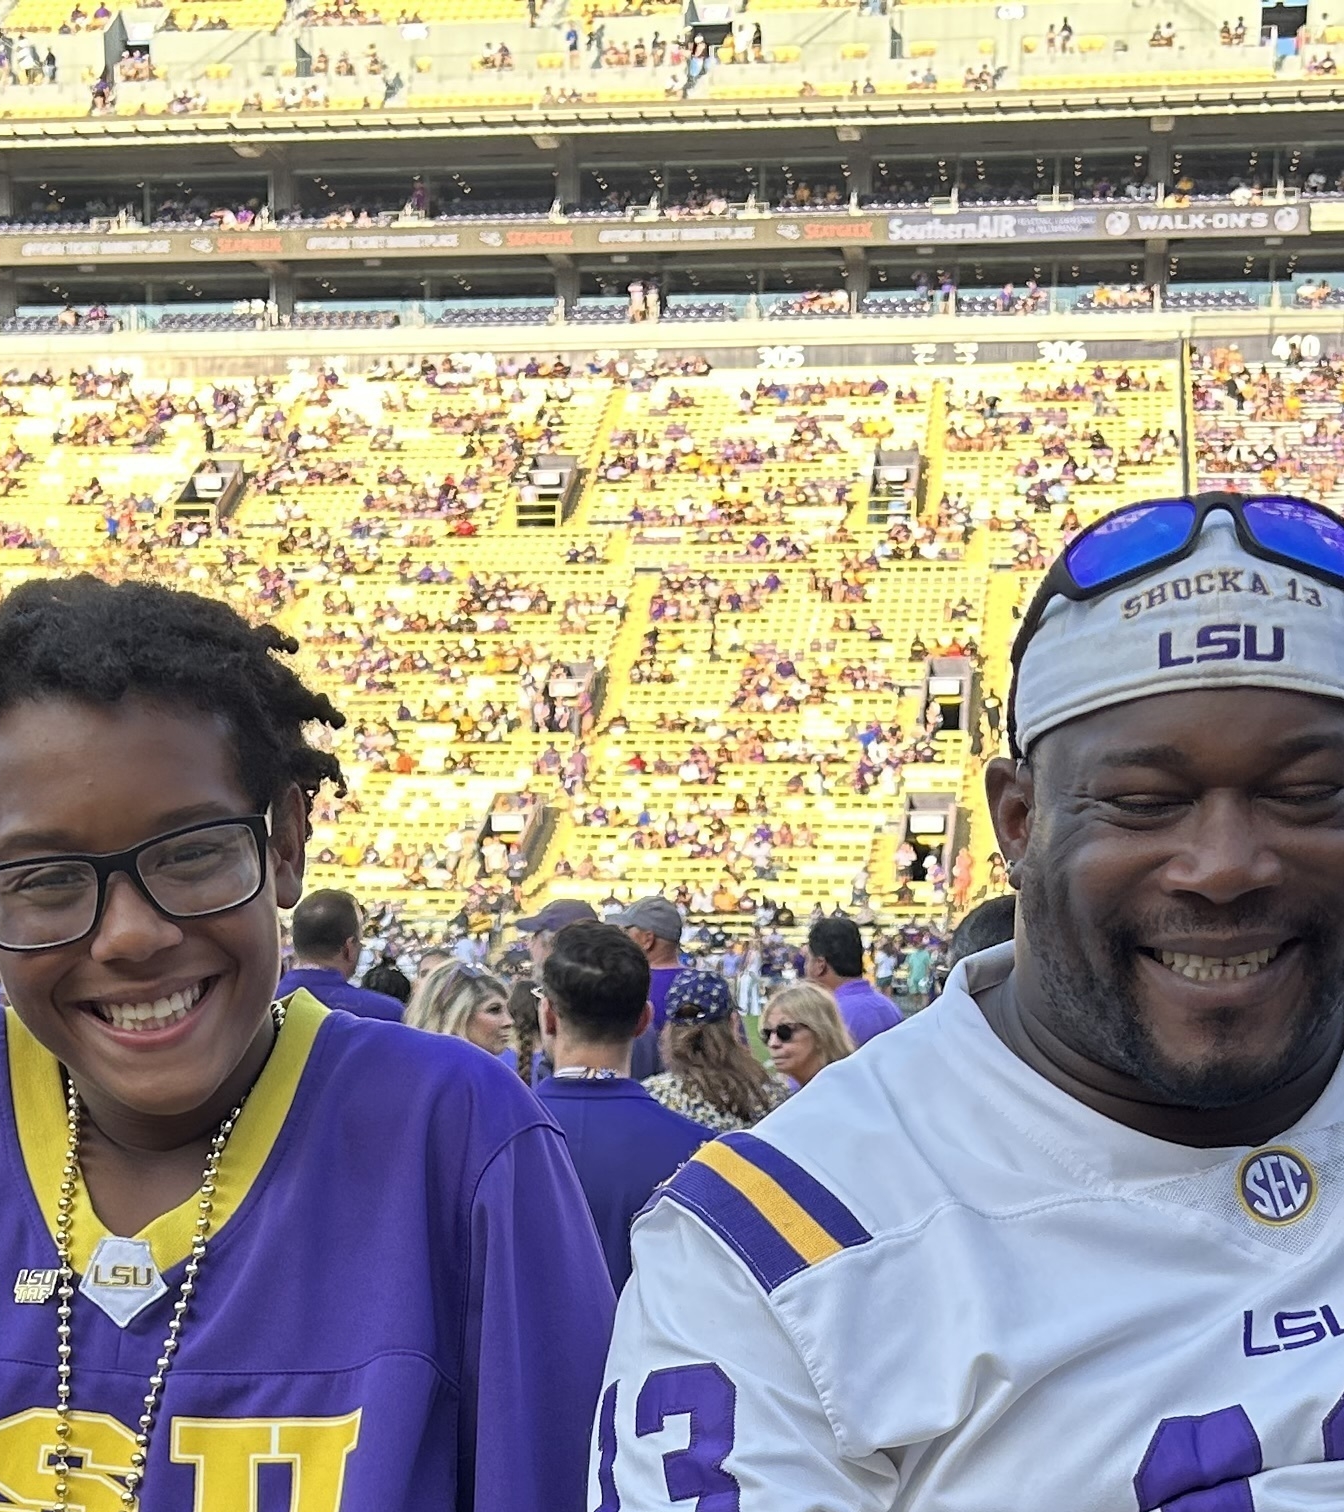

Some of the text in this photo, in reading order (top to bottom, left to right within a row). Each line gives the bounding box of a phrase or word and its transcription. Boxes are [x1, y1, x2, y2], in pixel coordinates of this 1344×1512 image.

[1136, 211, 1269, 231] WALK-ON'S
[756, 345, 805, 369] 305
[1036, 341, 1087, 364] 306
[1121, 568, 1324, 620] SHOCKA 13
[1158, 623, 1285, 669] LSU
[1245, 1154, 1308, 1218] SEC
[19, 1269, 58, 1286] LSU
[93, 1264, 153, 1287] LSU
